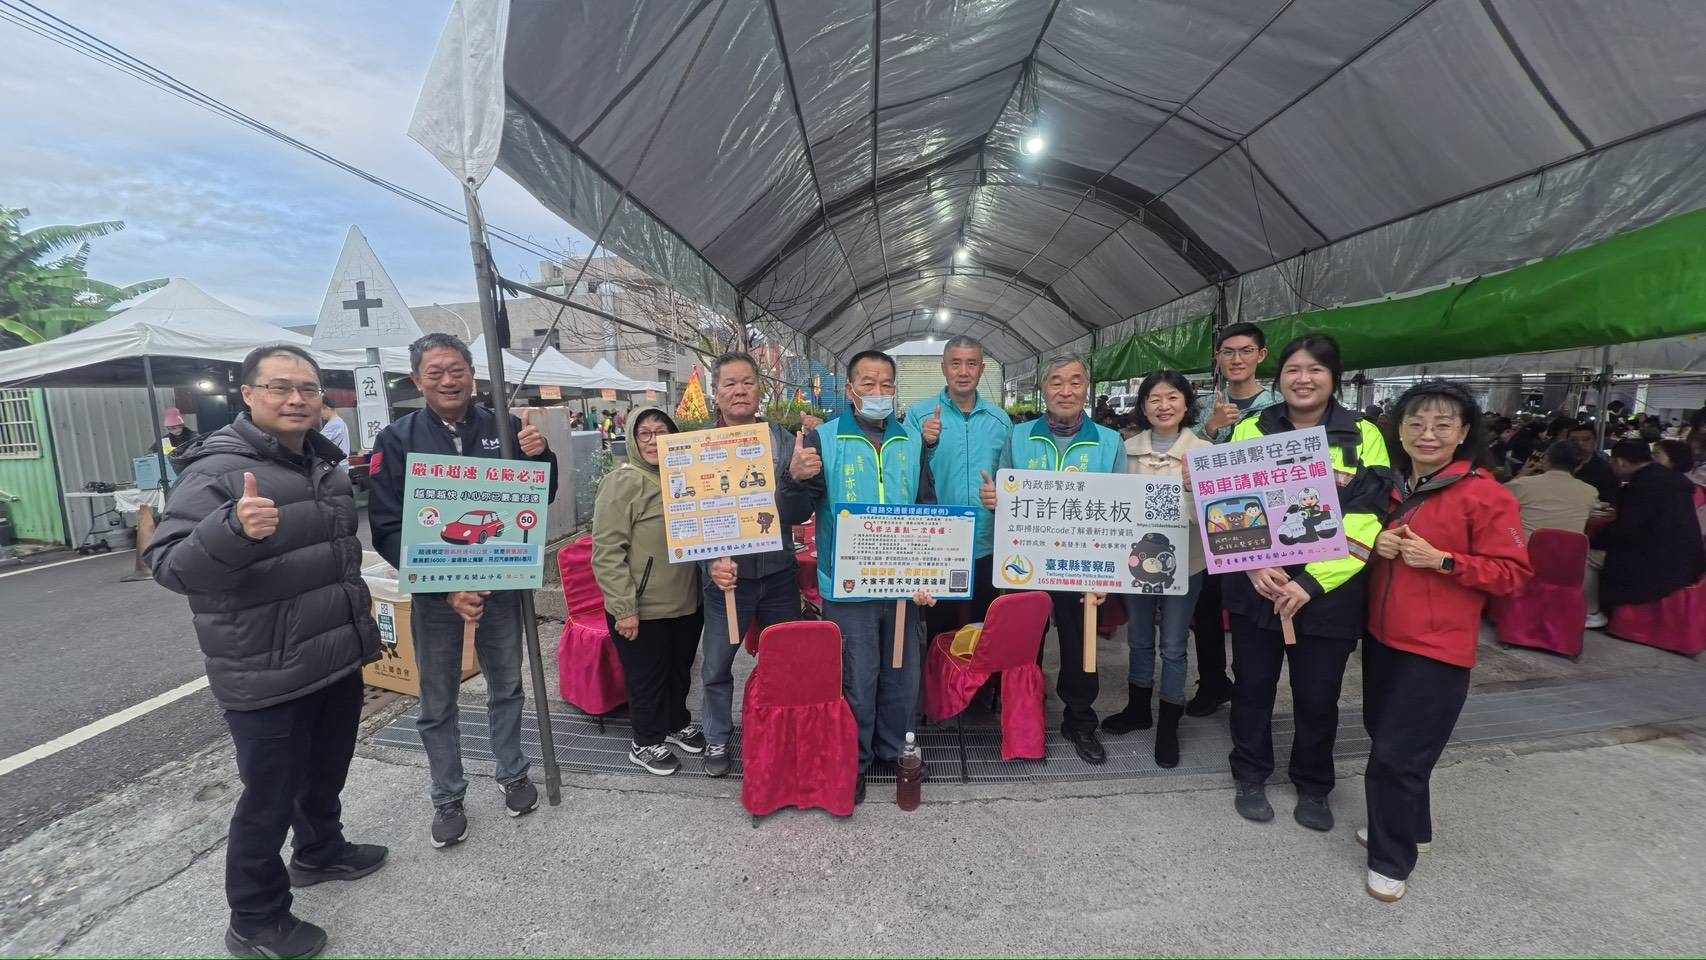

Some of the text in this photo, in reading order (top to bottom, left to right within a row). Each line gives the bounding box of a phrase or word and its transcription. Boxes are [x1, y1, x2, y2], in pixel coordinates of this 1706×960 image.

[1193, 435, 1322, 472] 乘車請繫安全帶
[411, 462, 545, 484] 嚴重超速 危險必罰
[1198, 460, 1328, 497] 騎車請戴安全帽
[1022, 479, 1086, 492] 內政部警政署
[521, 516, 533, 524] 50
[1010, 496, 1132, 523] 打詐儀錶板
[1045, 558, 1116, 574] 臺東縣警察局
